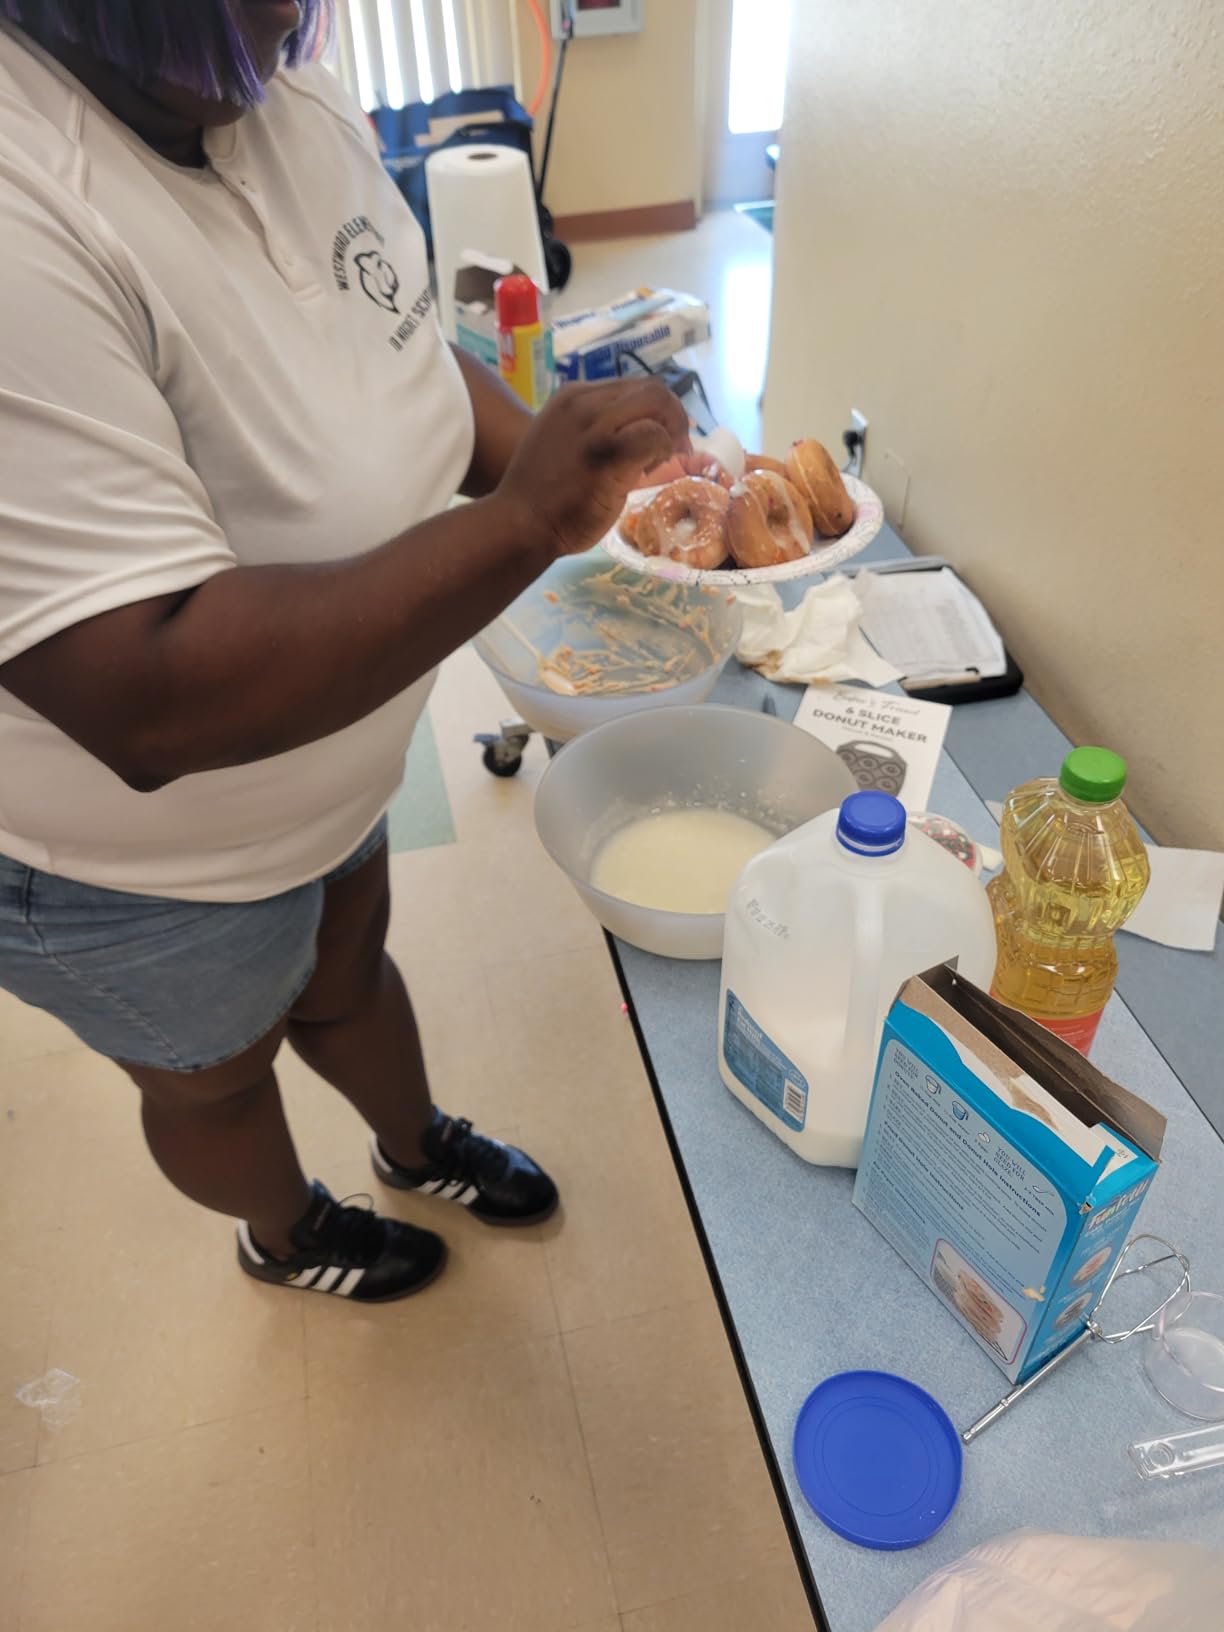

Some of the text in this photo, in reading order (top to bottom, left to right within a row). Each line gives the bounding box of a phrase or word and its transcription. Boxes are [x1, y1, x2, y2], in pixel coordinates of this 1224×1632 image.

[812, 708, 869, 729] DONUT
[871, 723, 928, 743] MAKER
[857, 709, 902, 725] SLICE
[893, 1069, 910, 1088] Oven
[909, 1085, 929, 1108] Baked
[929, 1104, 948, 1127] Donut
[948, 1125, 961, 1141] and
[961, 1137, 982, 1161] Donut
[982, 1158, 998, 1177] Hole
[999, 1173, 1041, 1217] Instructions
[897, 1135, 915, 1158] Donut
[915, 1155, 929, 1173] Hole
[928, 1170, 964, 1211] Instructions
